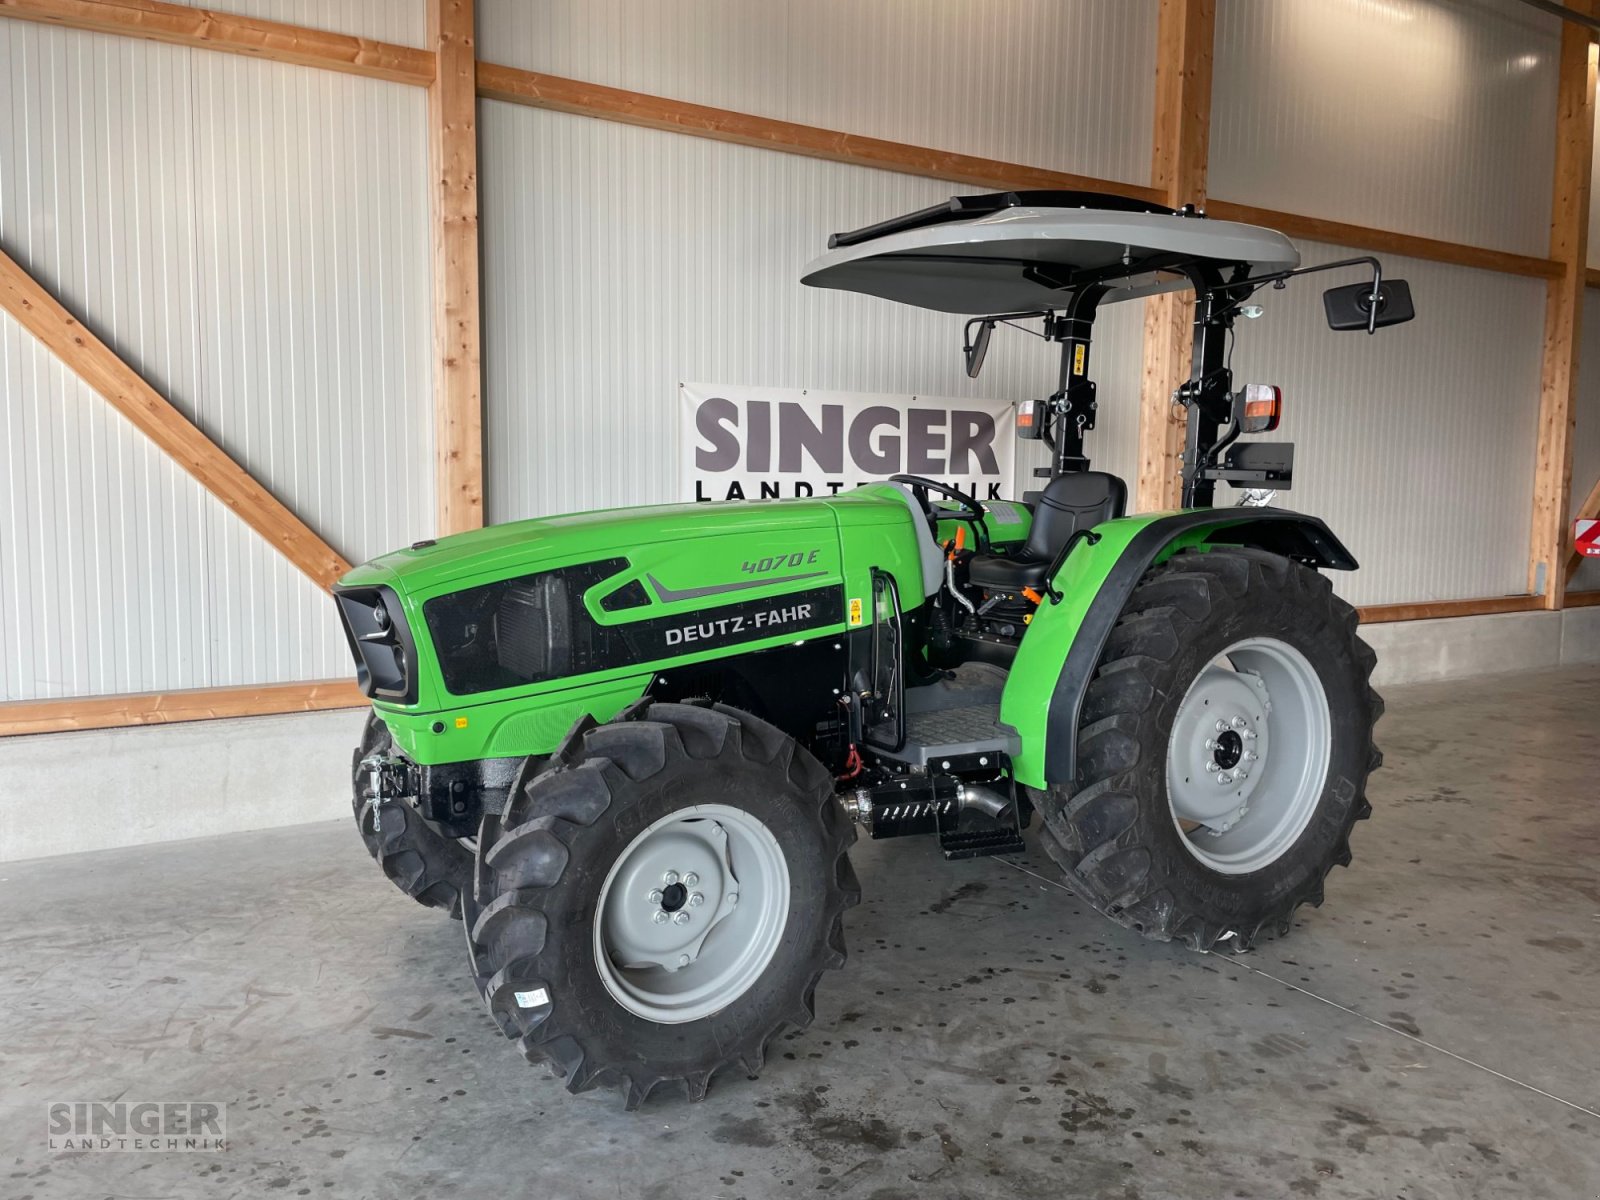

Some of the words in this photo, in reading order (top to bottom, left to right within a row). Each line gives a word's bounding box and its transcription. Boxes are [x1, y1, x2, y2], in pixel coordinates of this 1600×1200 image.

[695, 397, 1001, 475] SINGER
[741, 552, 804, 574] 4070
[807, 549, 821, 564] E
[665, 603, 812, 646] DEUTZ-FAHR
